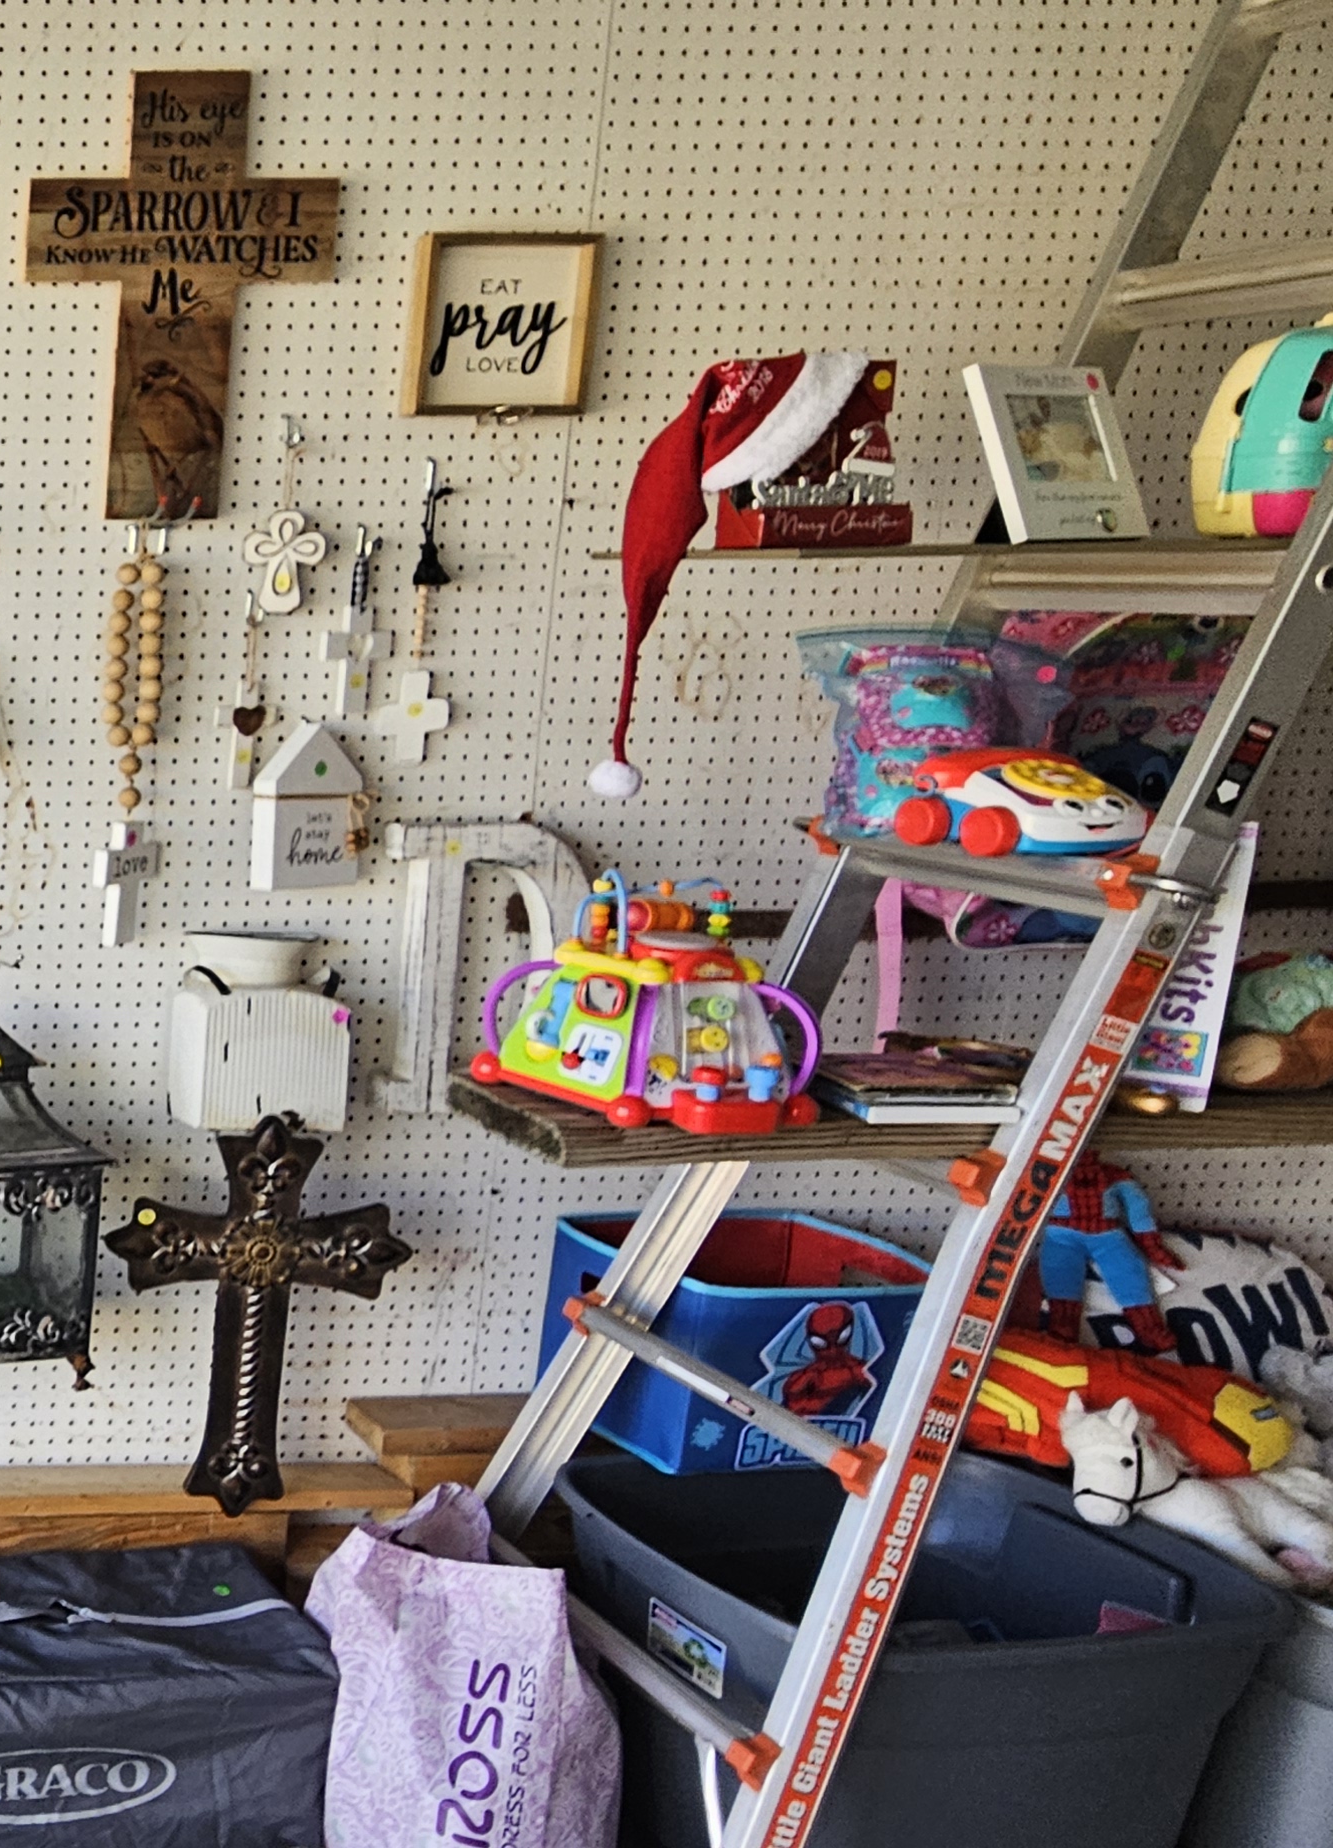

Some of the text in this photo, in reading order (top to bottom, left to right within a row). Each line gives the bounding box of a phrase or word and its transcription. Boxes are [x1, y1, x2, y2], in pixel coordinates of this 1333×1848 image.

[140, 88, 243, 135] His eye
[153, 131, 213, 148] IS ON
[169, 155, 210, 183] the
[54, 186, 256, 239] SPARROW
[284, 190, 305, 228] I
[44, 245, 121, 265] KNOW
[154, 233, 319, 279] WATCHES
[141, 267, 202, 316] Me
[480, 278, 522, 296] EAT
[429, 301, 569, 378] pray
[465, 357, 519, 373] LOVE
[112, 854, 149, 879] love
[285, 825, 344, 868] home
[924, 1408, 957, 1430] 300
[791, 1715, 840, 1794] Giant
[823, 1606, 882, 1712] Ladder
[865, 1472, 931, 1602] Systems
[515, 1665, 538, 1723] LESS
[436, 1658, 512, 1848] ROSS
[511, 1731, 531, 1777] FOR
